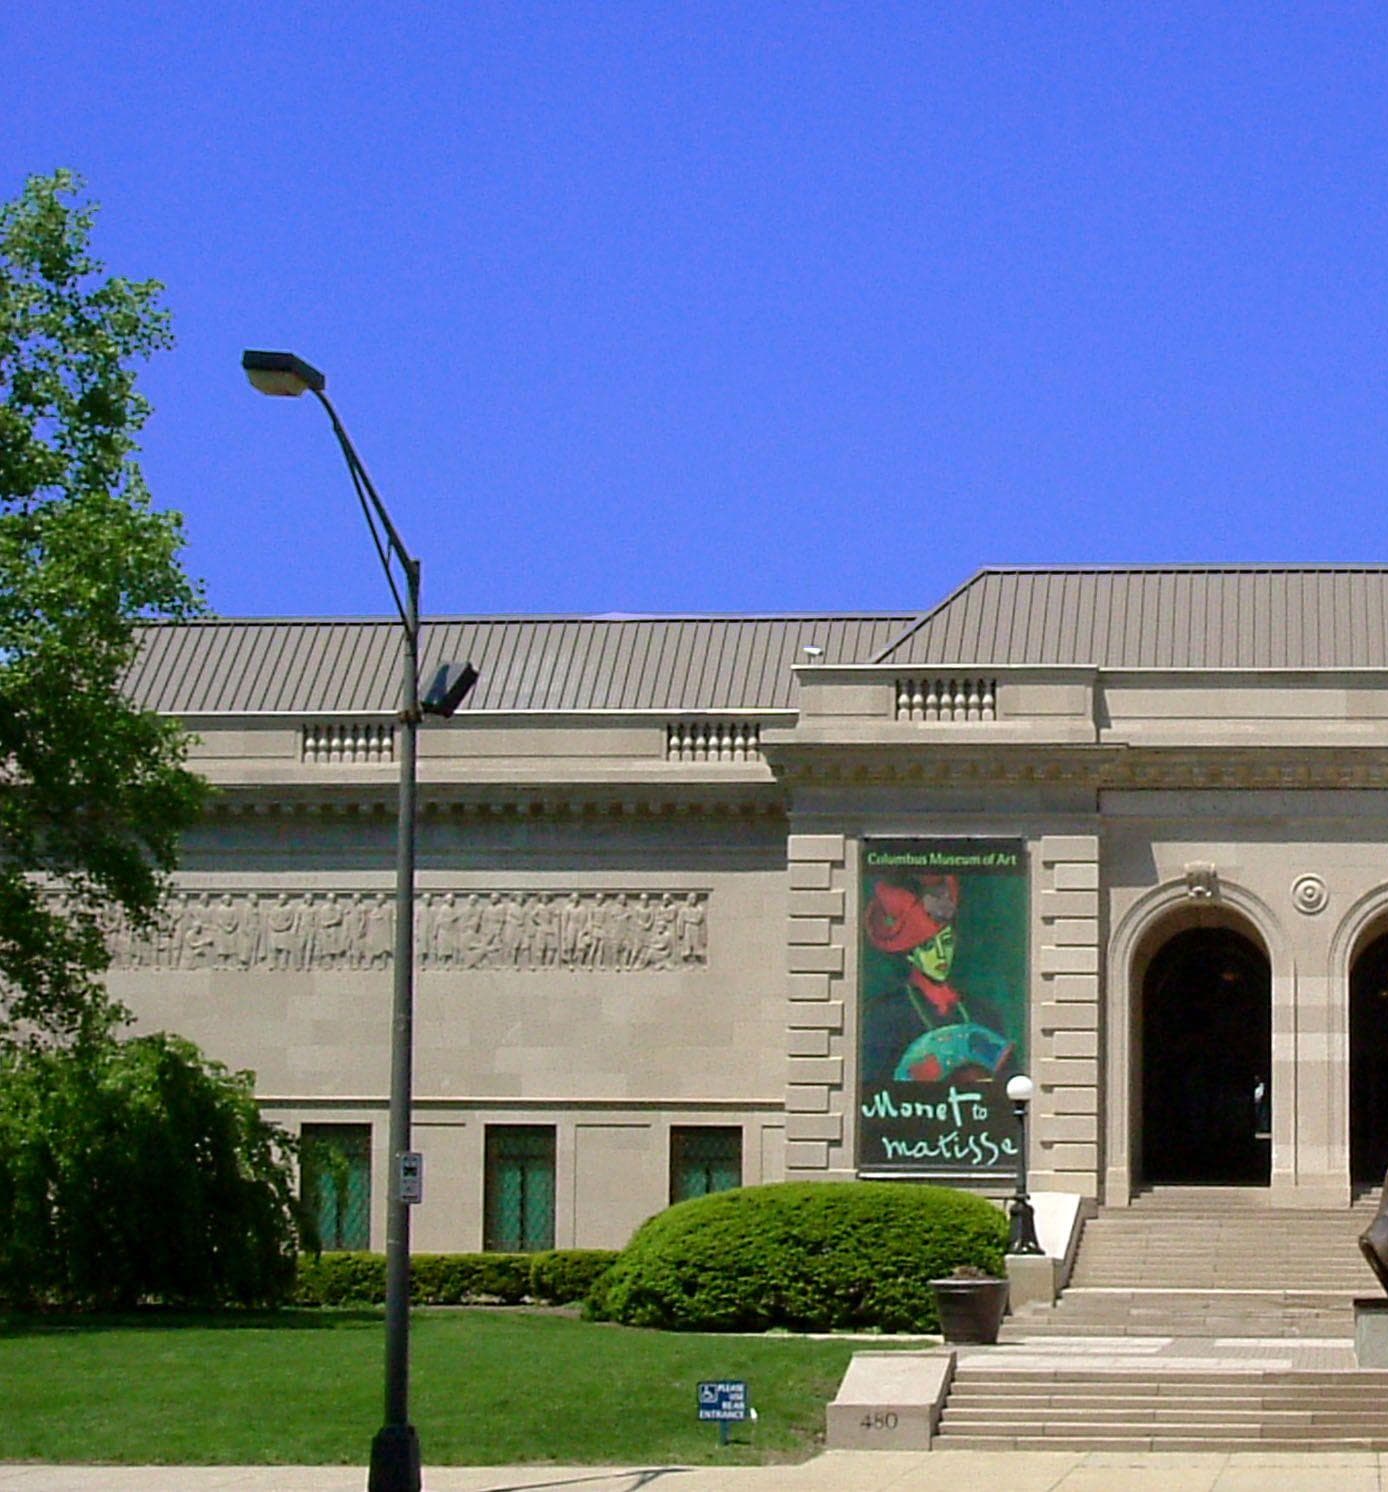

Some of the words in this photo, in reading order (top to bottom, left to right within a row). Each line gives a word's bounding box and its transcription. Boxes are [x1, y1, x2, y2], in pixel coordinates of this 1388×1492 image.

[867, 852, 927, 866] Columbus
[929, 852, 981, 866] Museum
[982, 852, 995, 866] of
[996, 852, 1018, 867] Art
[861, 1086, 982, 1127] Monet
[972, 1103, 988, 1121] to
[699, 1410, 745, 1419] ENTRANCE
[860, 1412, 899, 1431] 480
